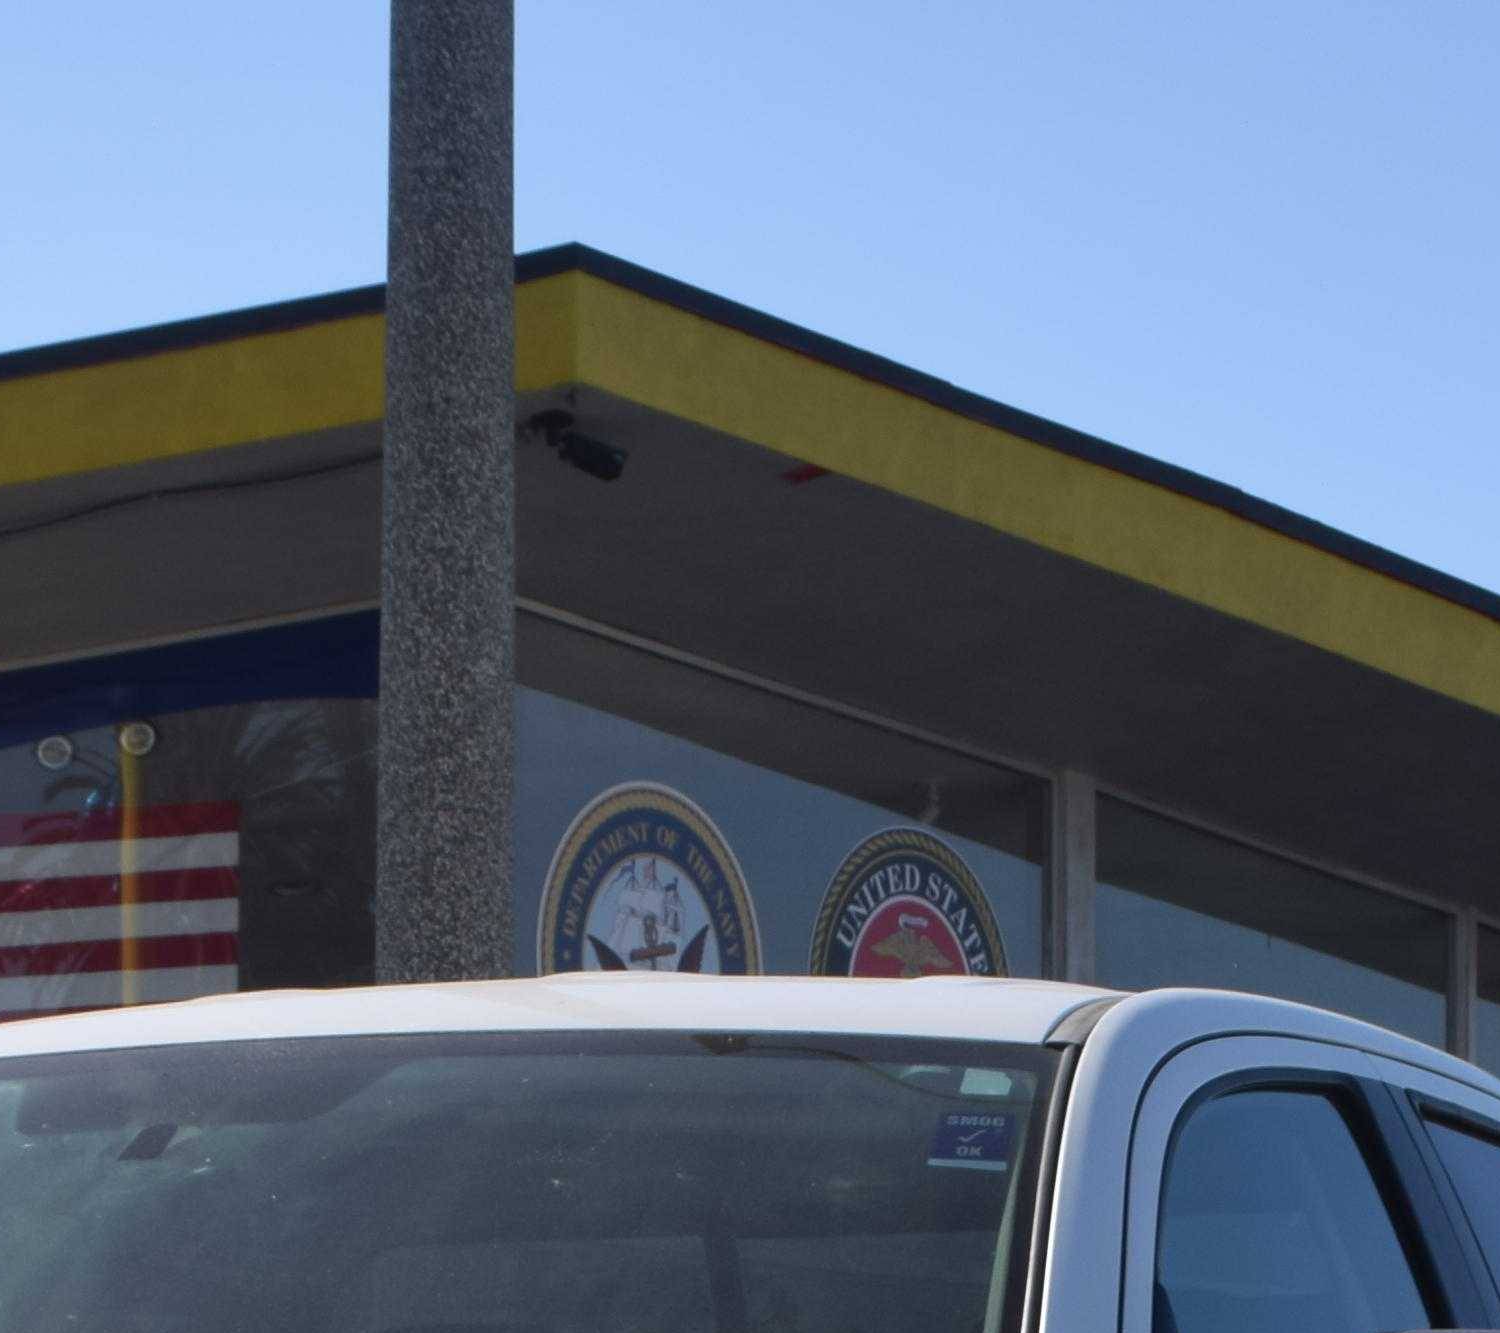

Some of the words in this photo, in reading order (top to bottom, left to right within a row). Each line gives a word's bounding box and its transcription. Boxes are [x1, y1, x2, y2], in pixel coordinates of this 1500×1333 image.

[836, 863, 921, 948] UNITED
[945, 1114, 1006, 1128] SMOG
[955, 1145, 984, 1157] OK
